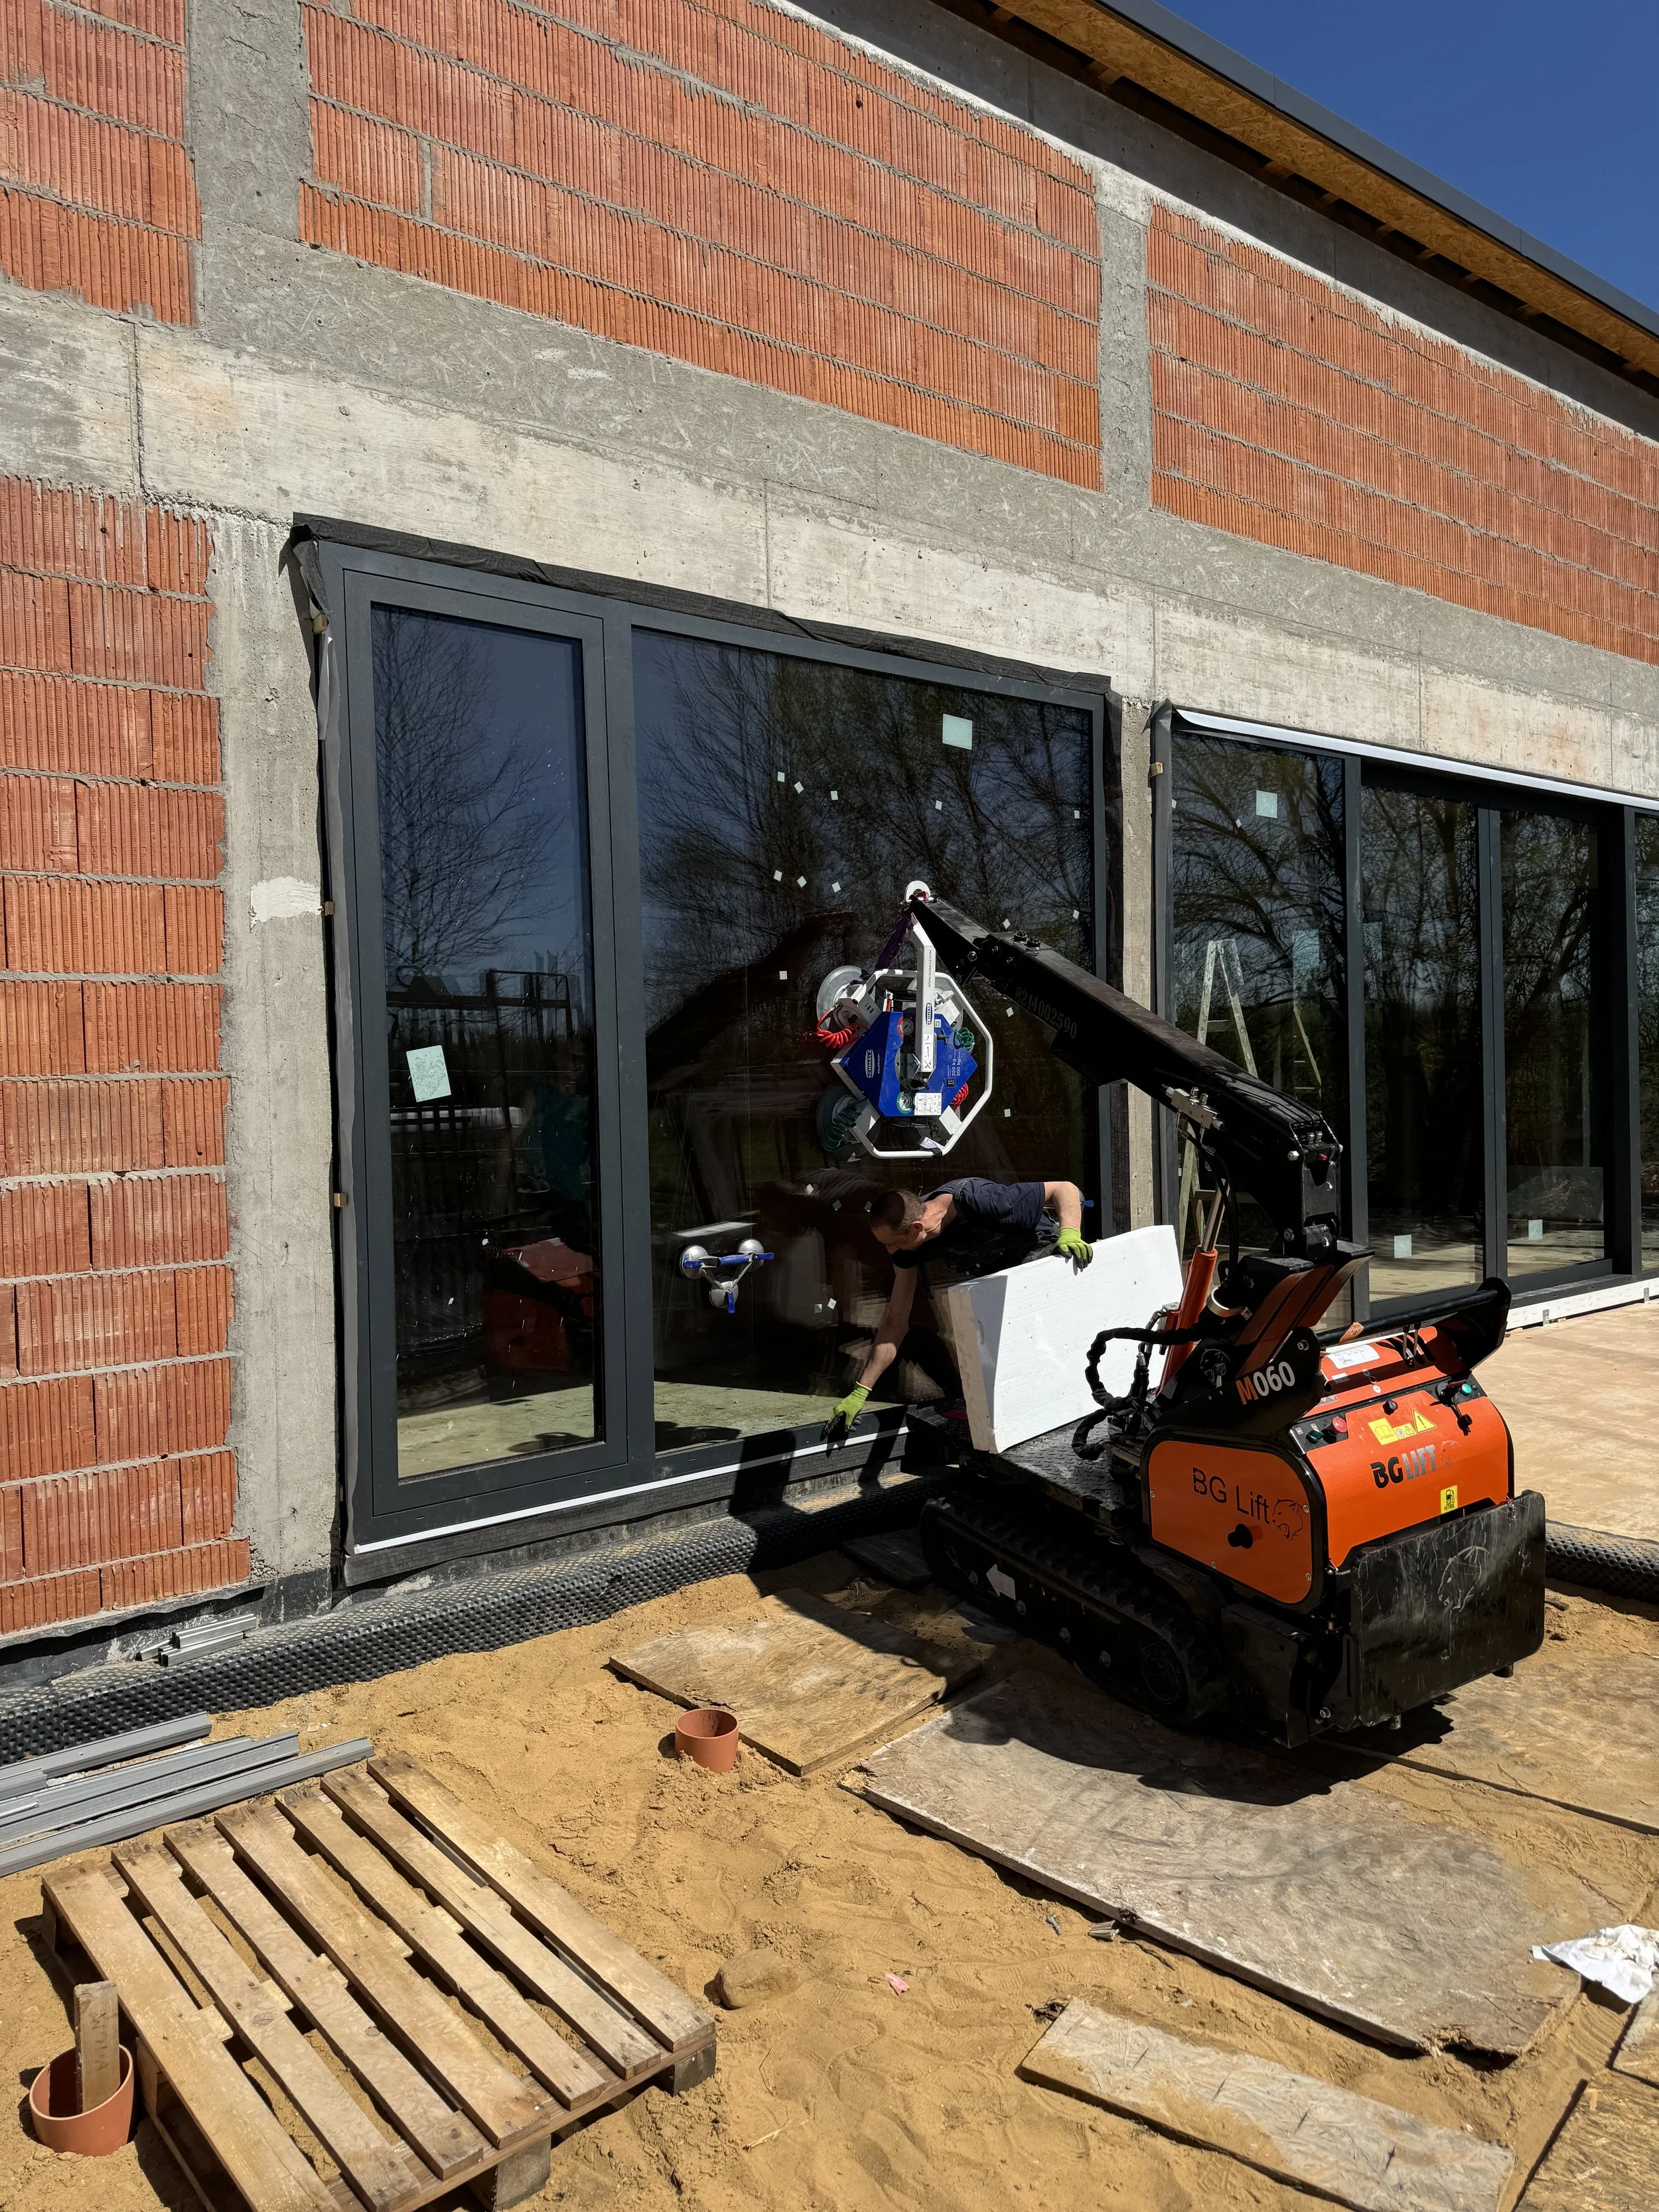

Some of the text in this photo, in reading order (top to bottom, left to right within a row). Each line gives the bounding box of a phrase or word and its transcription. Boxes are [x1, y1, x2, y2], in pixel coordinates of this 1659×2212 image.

[1015, 986, 1077, 1039] 8214002590
[1236, 1361, 1295, 1405] M060
[1192, 1467, 1270, 1524] BG Lift
